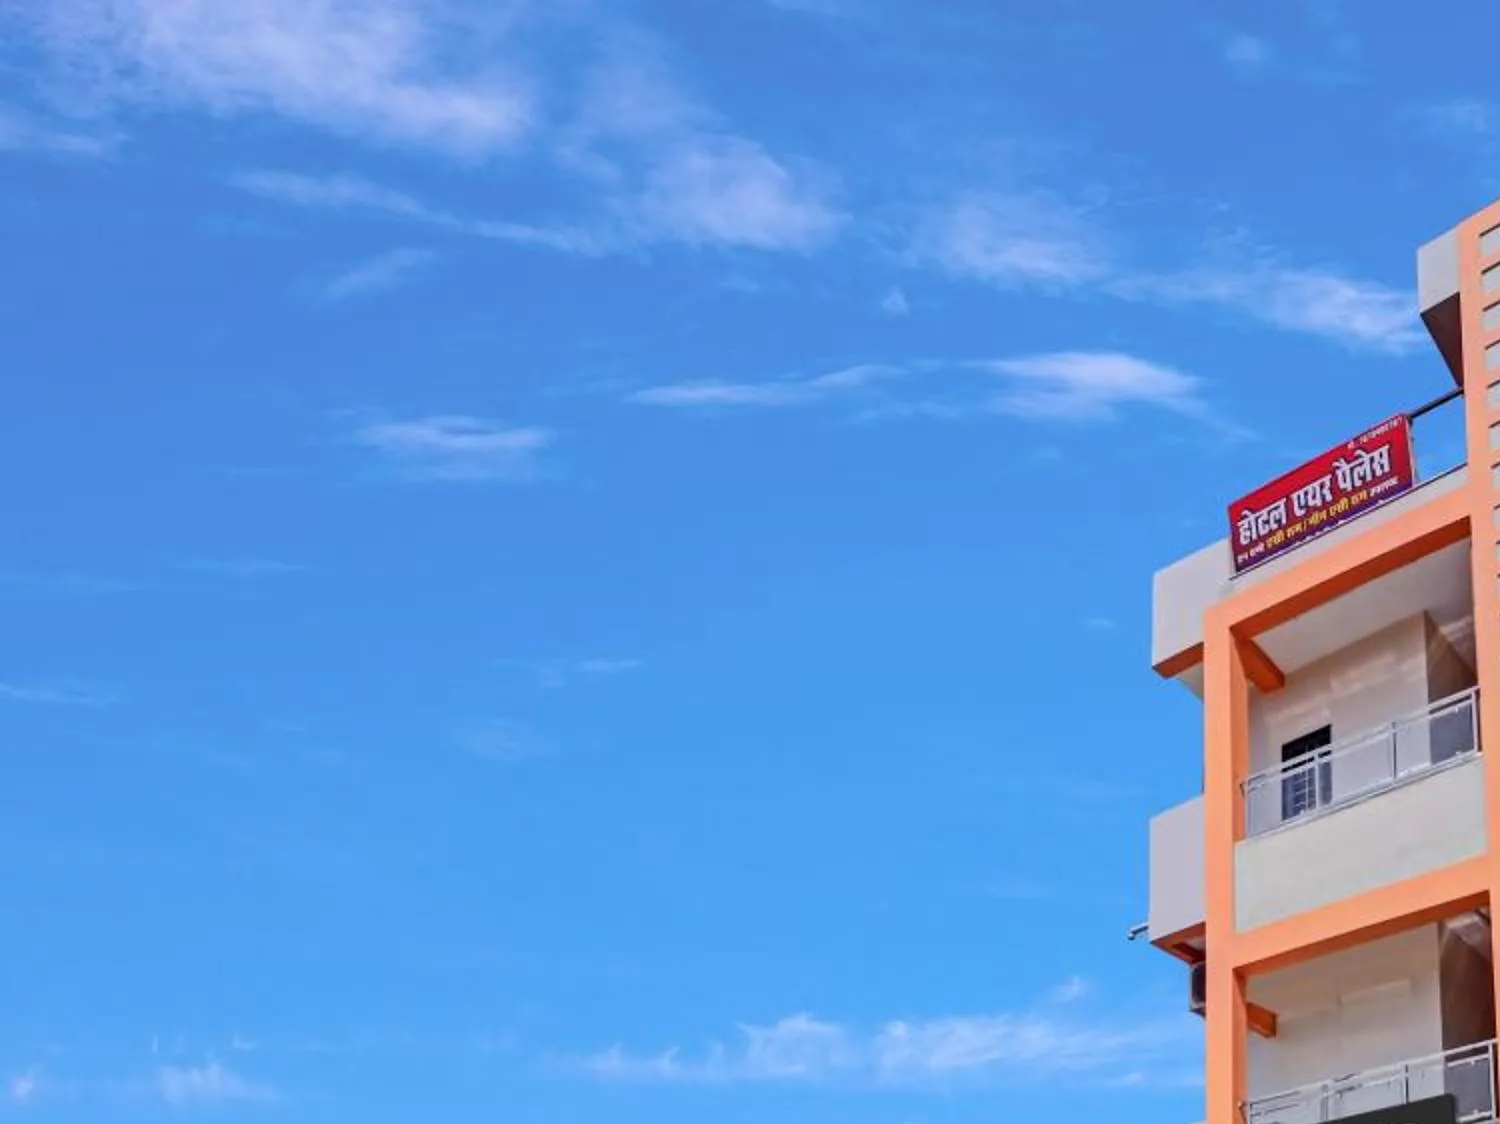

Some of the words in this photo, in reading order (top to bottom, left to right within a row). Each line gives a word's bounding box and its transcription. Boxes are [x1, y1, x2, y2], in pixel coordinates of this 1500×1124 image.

[1236, 496, 1287, 545] होटल
[1290, 473, 1333, 517] एयर
[1331, 444, 1390, 492] पैलेस
